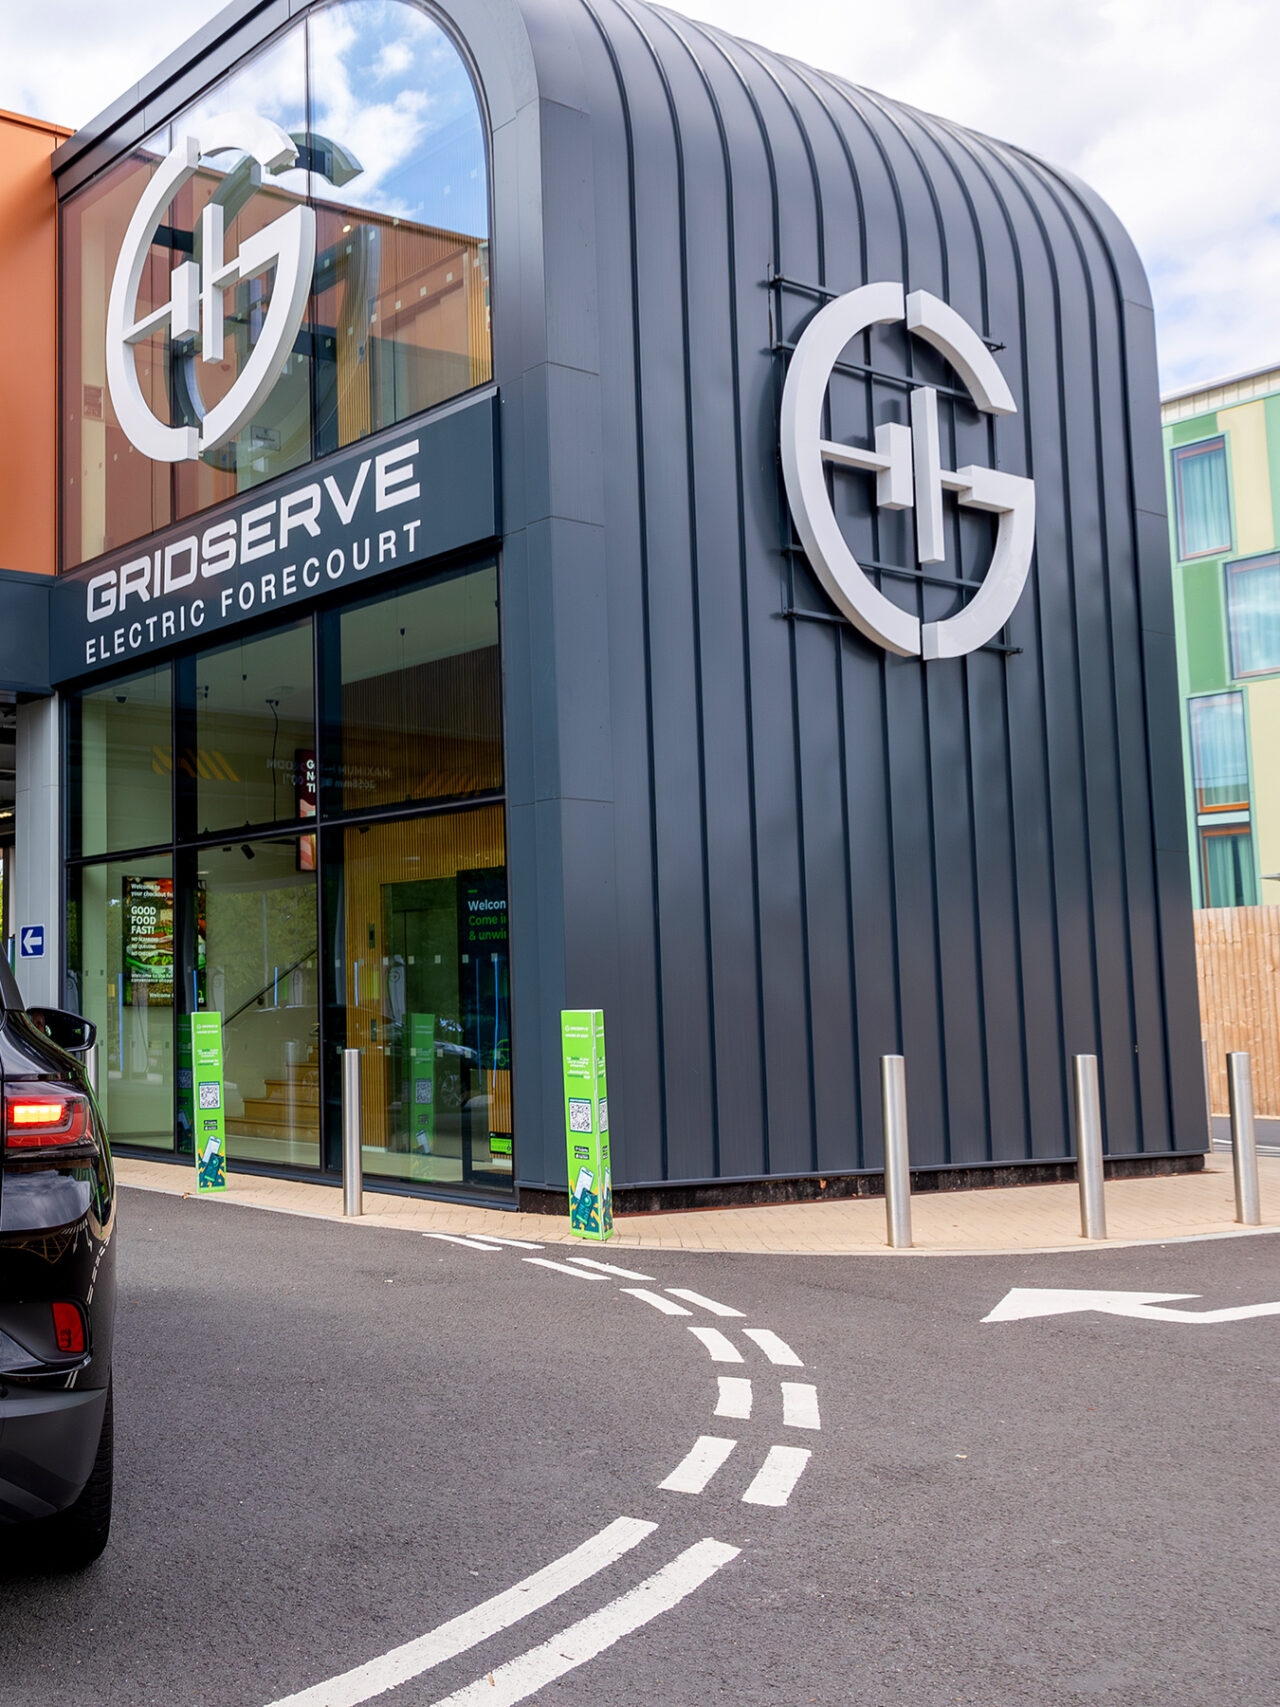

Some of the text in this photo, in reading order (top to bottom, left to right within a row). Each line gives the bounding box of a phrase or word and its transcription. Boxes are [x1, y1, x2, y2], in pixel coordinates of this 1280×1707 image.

[86, 438, 421, 624] GRIDSERVE
[85, 519, 422, 665] ELECTRIC FORECOURT
[131, 906, 156, 915] GOOD
[131, 916, 156, 925] FOOD
[468, 915, 498, 925] Come
[131, 926, 155, 934] FAST!
[469, 930, 476, 940] &
